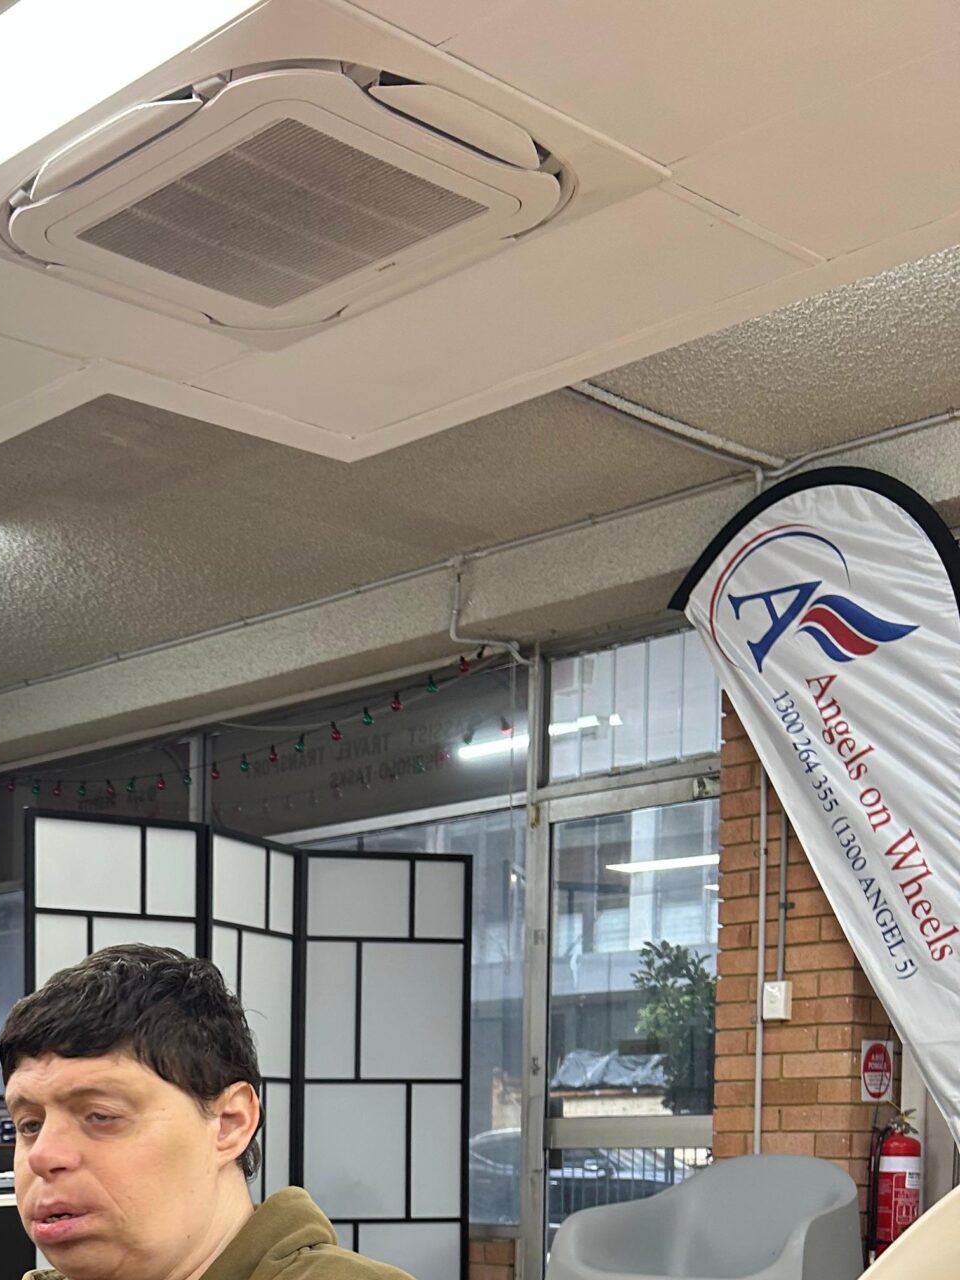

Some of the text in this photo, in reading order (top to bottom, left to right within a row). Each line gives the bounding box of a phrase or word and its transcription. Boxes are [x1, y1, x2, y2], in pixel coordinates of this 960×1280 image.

[772, 690, 919, 980] 1300 264 355 (1300 ANGEL 5)
[805, 674, 960, 962] Angels on Wheels
